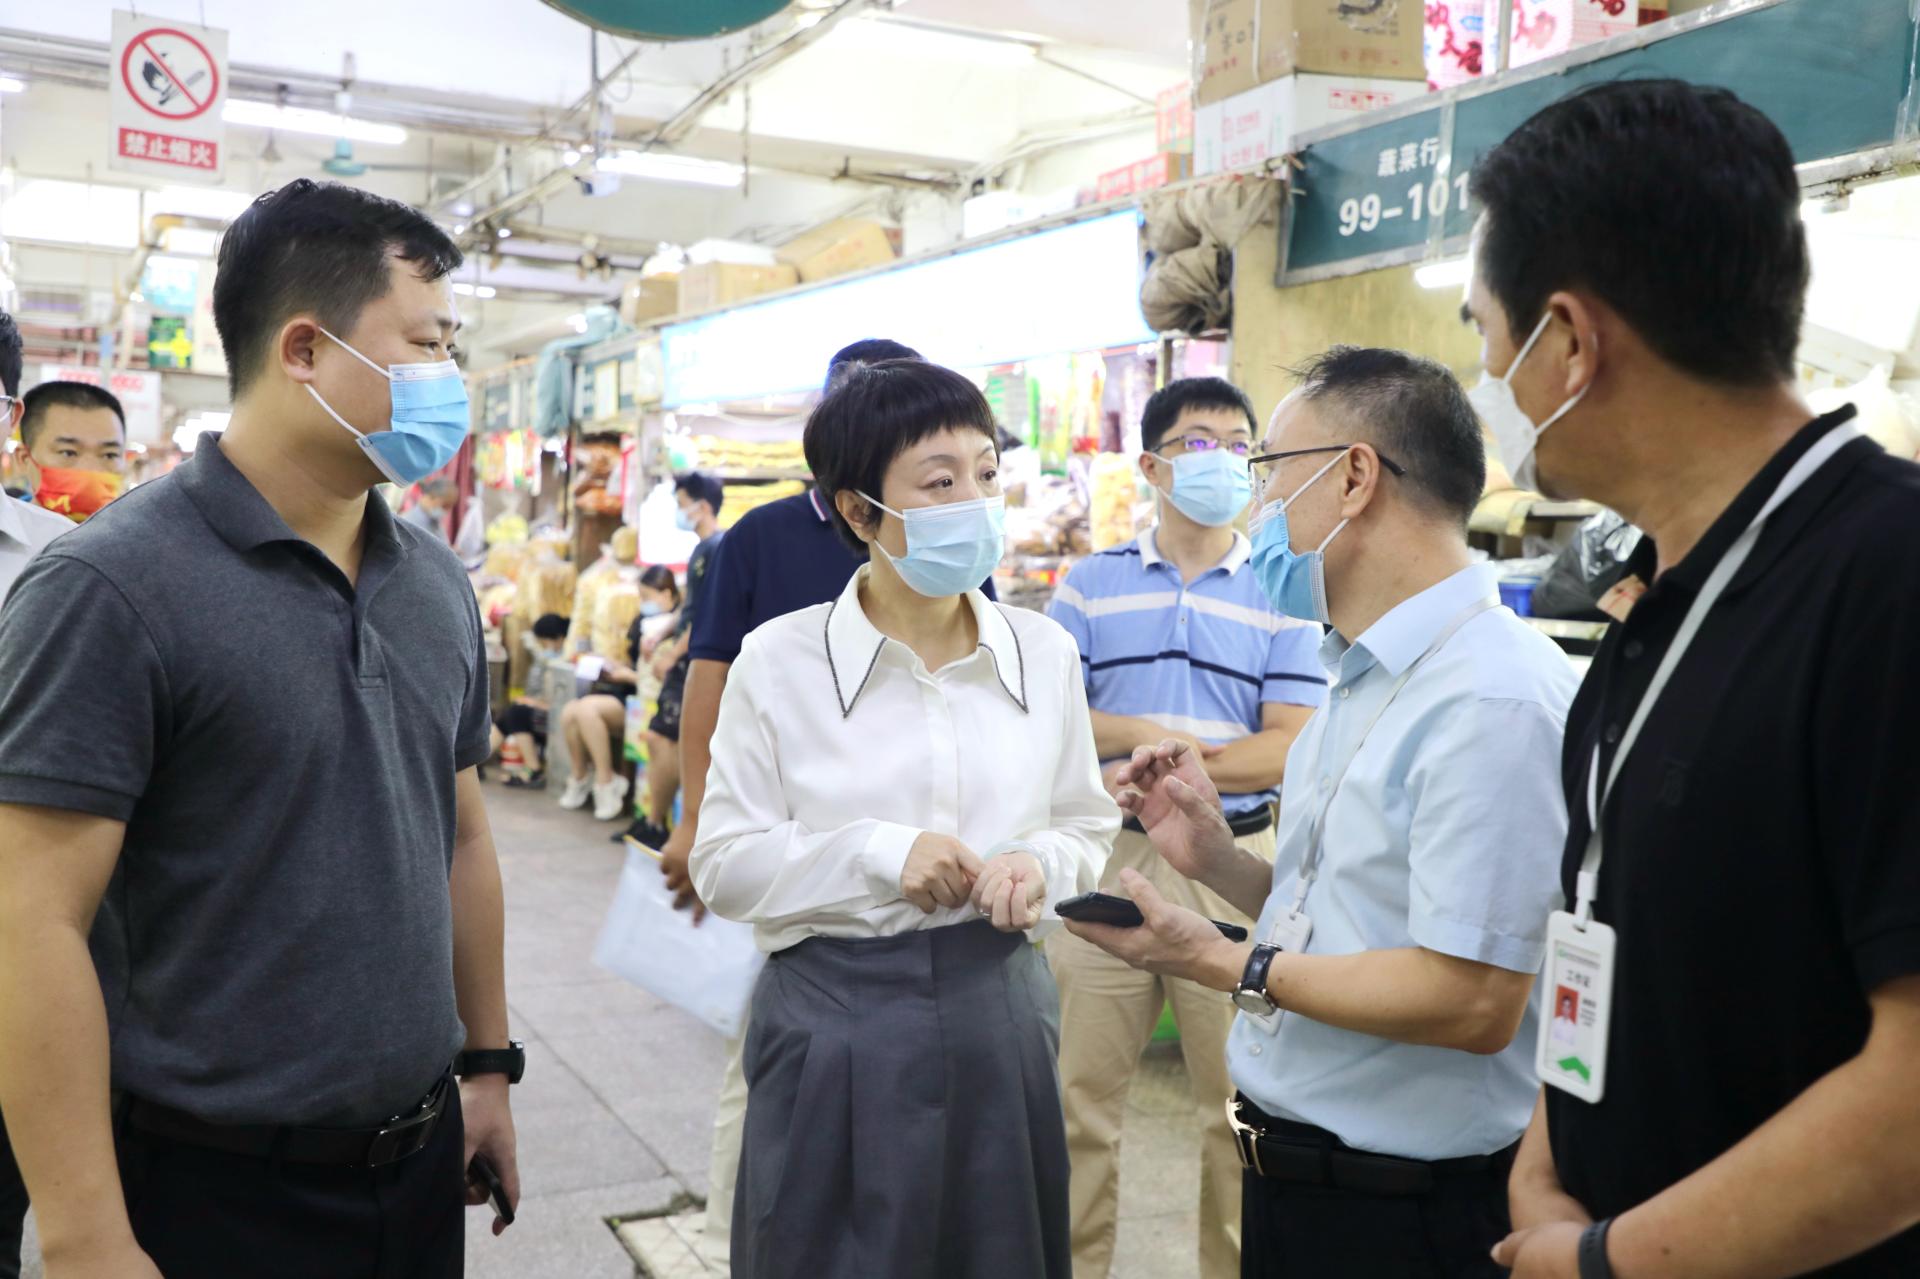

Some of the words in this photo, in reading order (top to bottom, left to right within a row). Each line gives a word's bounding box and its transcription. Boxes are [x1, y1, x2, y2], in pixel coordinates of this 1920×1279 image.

[125, 132, 212, 166] 禁止烟火
[1377, 137, 1441, 177] 蔬菜行
[1338, 171, 1469, 237] 99-101
